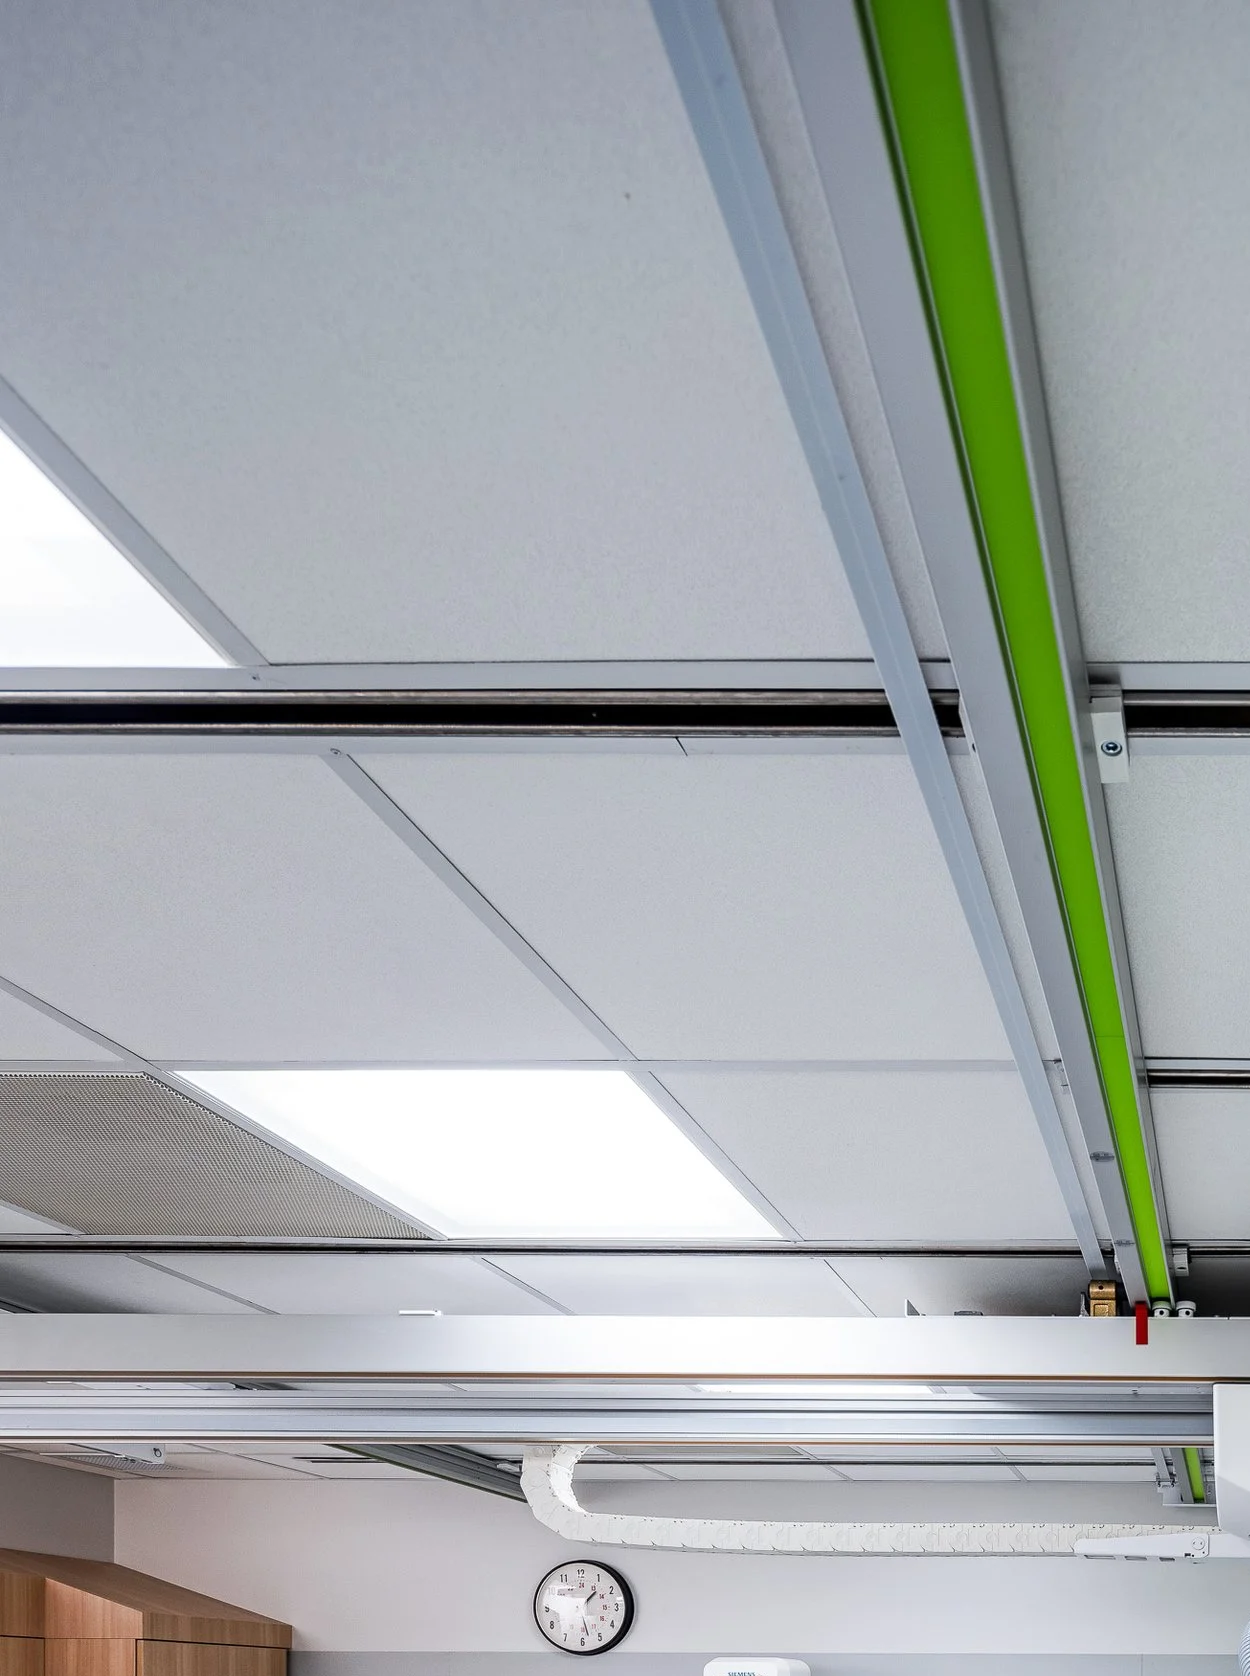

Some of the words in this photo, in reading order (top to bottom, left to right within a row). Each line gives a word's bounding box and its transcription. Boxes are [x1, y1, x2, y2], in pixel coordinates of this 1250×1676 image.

[577, 1569, 585, 1578] 12
[597, 1574, 600, 1582] 1
[560, 1574, 568, 1583] 11
[609, 1585, 614, 1594] 2
[544, 1604, 550, 1613] 9
[614, 1602, 619, 1611] 3
[549, 1620, 555, 1629] 8
[610, 1619, 615, 1629] 4
[563, 1633, 568, 1642] 7
[580, 1637, 585, 1646] 6
[598, 1633, 602, 1641] 5
